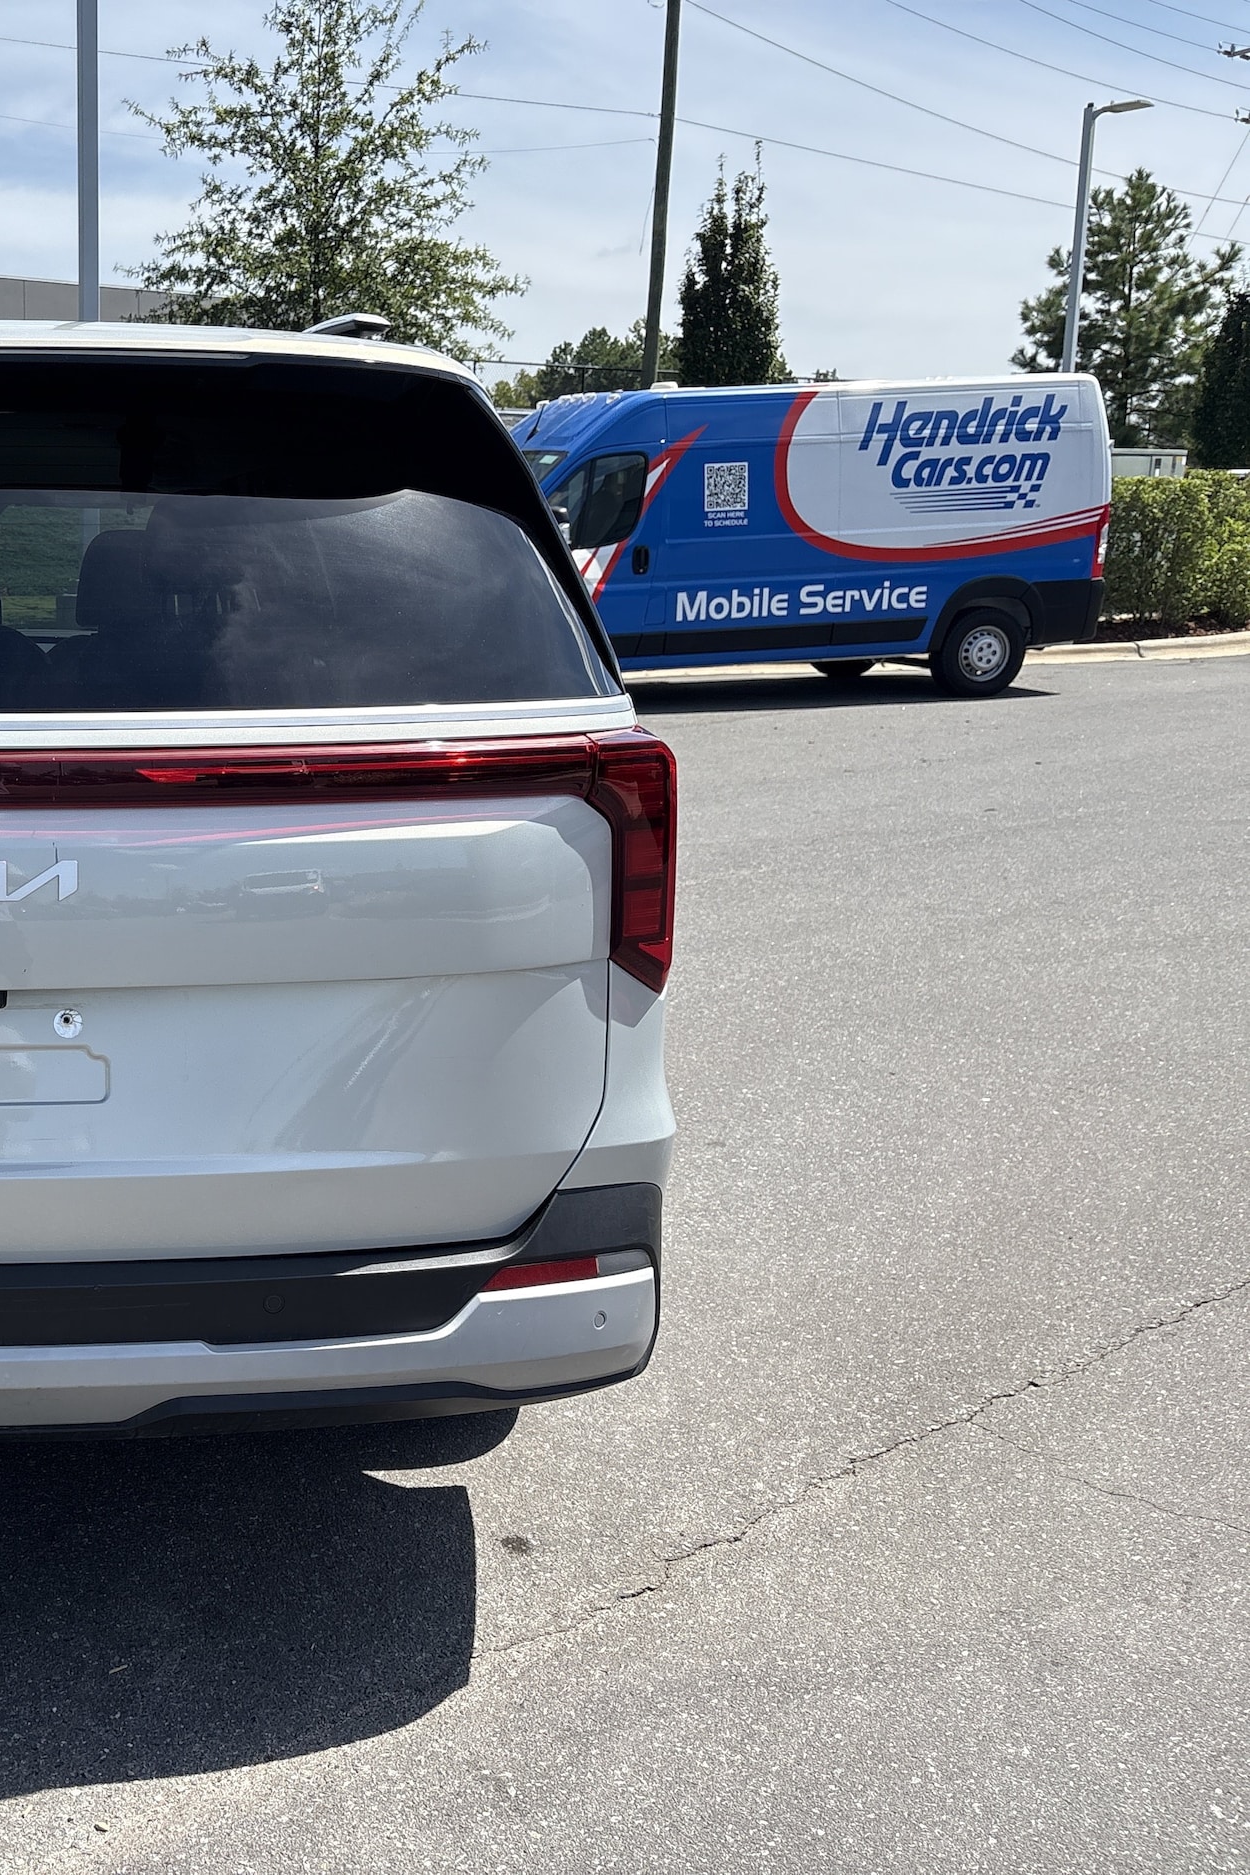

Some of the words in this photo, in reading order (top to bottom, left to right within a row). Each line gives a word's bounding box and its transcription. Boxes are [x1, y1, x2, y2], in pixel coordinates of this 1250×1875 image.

[858, 394, 1068, 466] Hendrick
[891, 450, 1050, 488] Cars.com
[707, 511, 726, 519] SCAN
[714, 518, 748, 527] SCHEDULE
[676, 587, 789, 622] Mobile
[799, 580, 928, 615] Service
